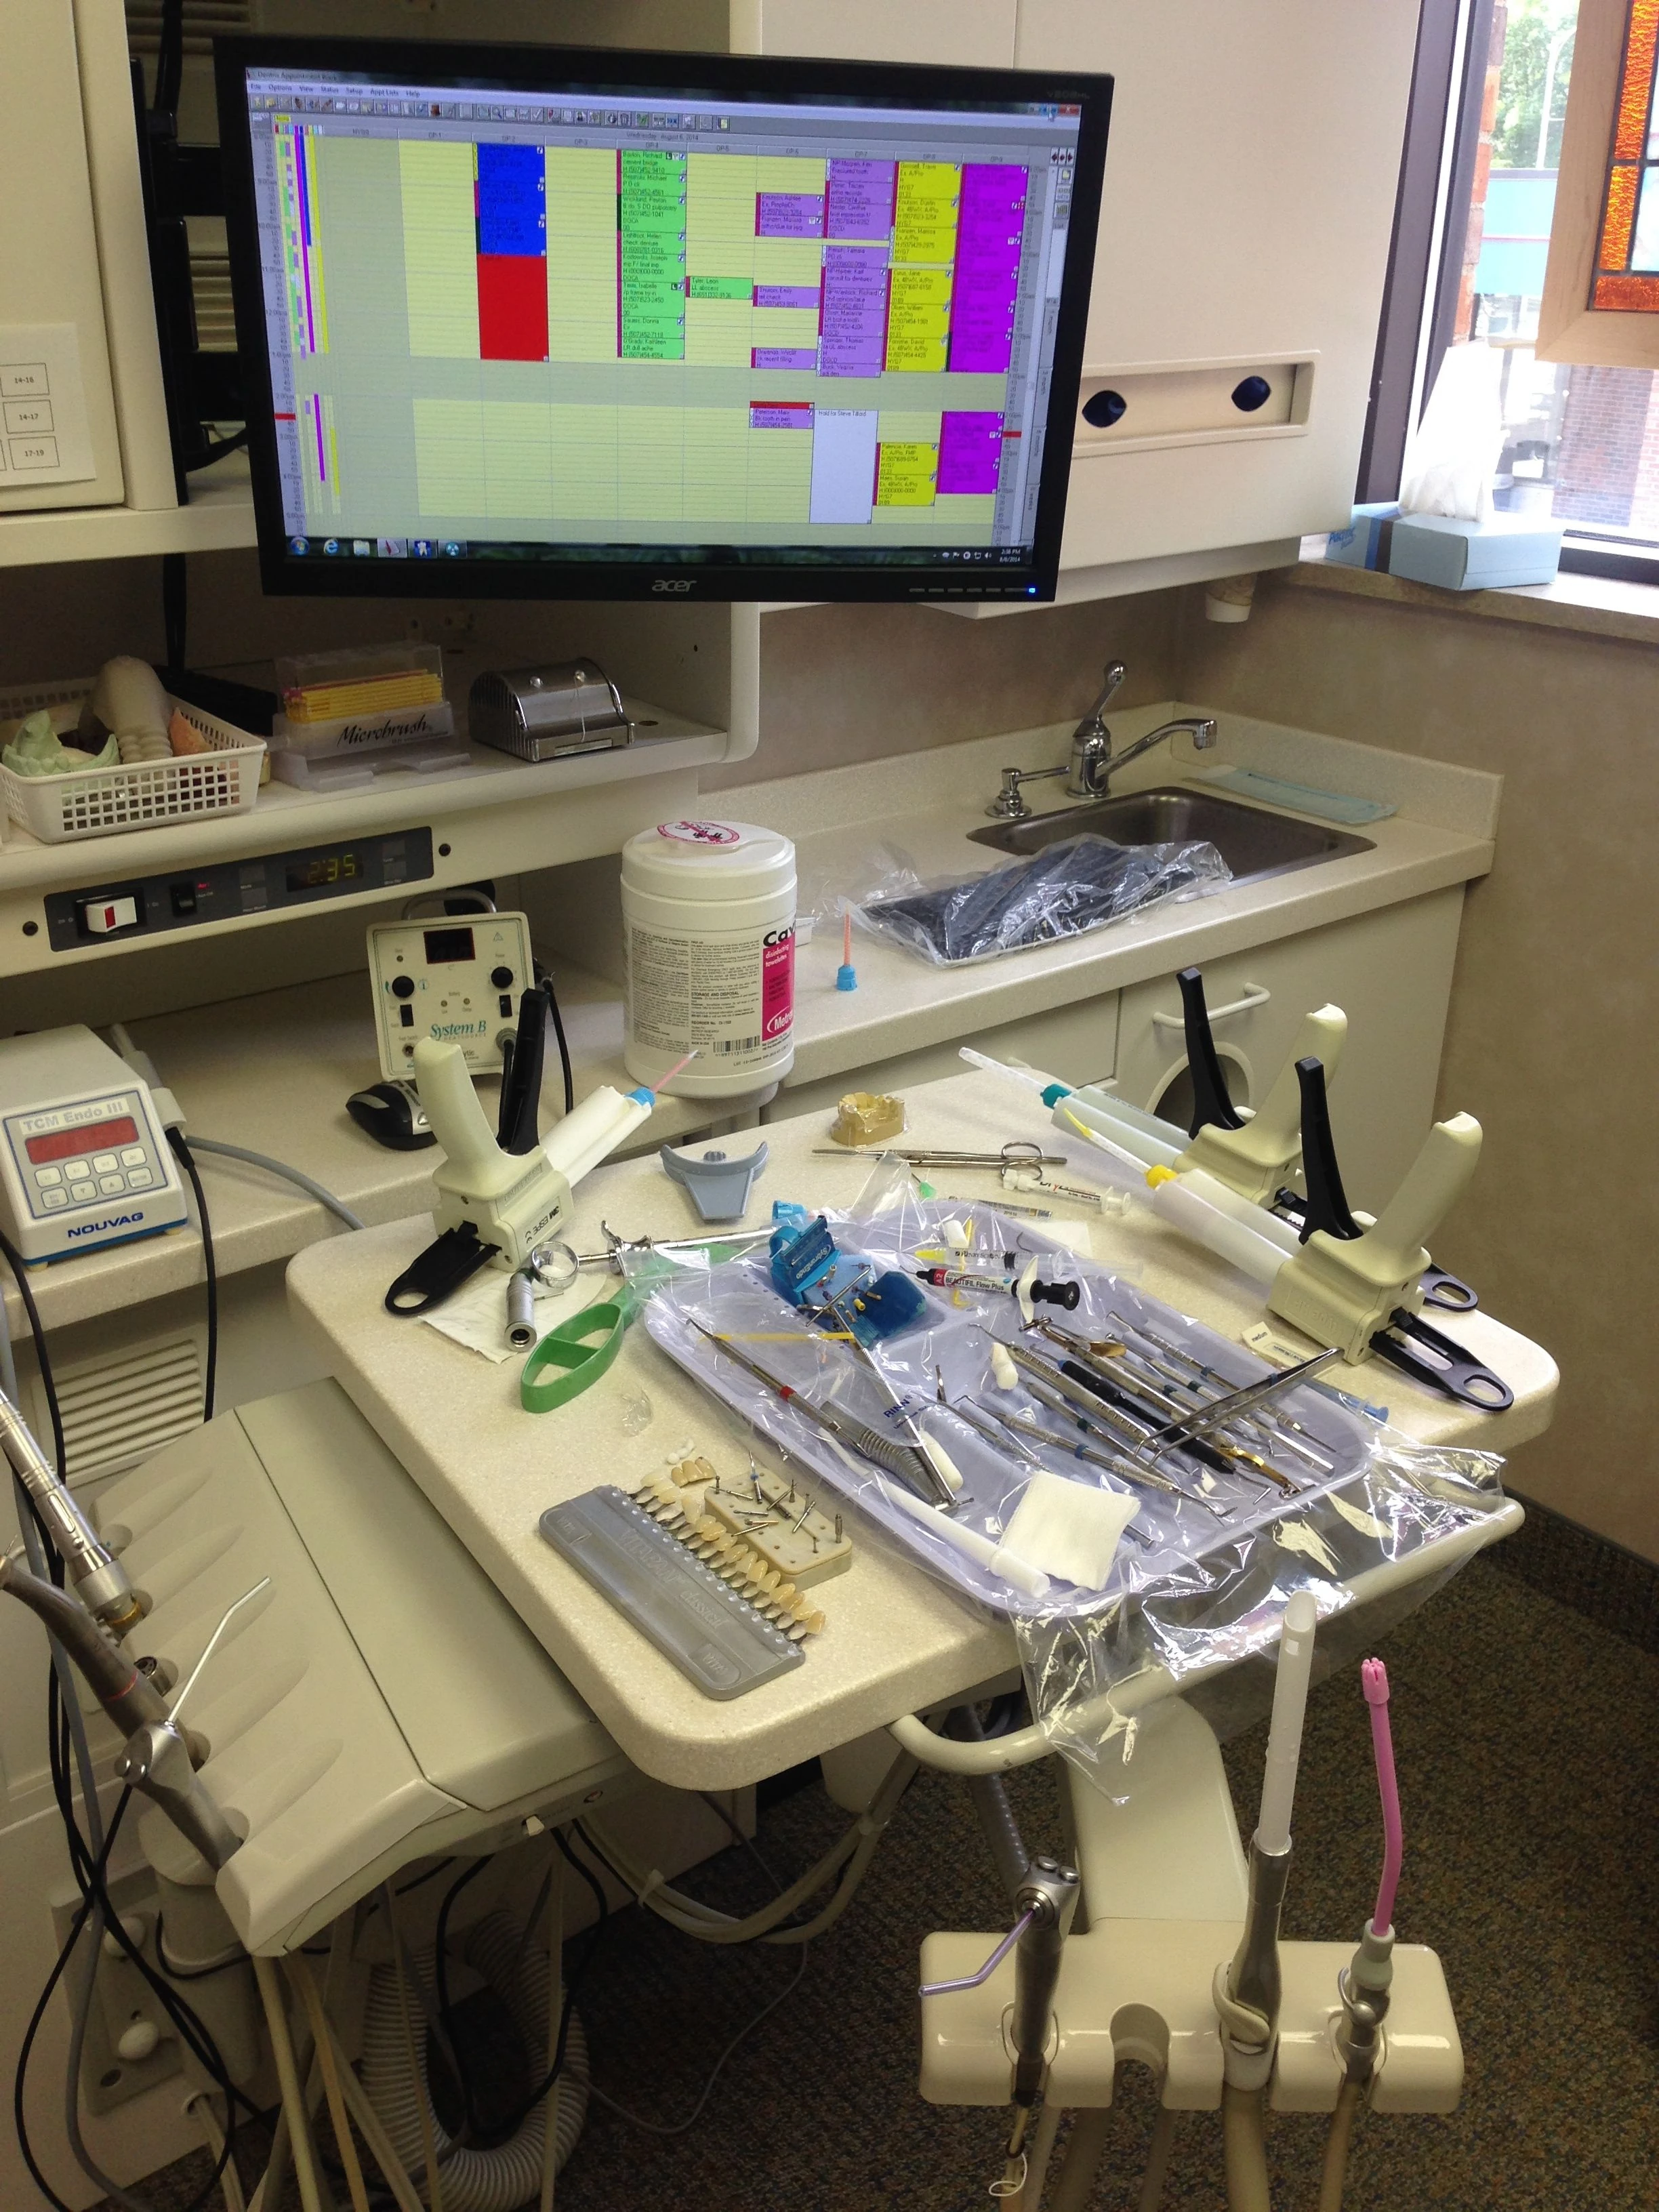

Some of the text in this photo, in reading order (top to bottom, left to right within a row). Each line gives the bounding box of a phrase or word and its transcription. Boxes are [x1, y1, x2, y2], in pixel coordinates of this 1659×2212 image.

[268, 84, 292, 92] Options
[14, 375, 34, 384] 14-16
[19, 413, 39, 421] 14-17
[24, 449, 44, 457] 17-19
[652, 579, 697, 592] acer
[337, 713, 428, 747] Microbrush
[308, 854, 356, 884] 2:35
[765, 943, 790, 960] disinfecting
[765, 954, 787, 968] towelettes
[430, 1019, 487, 1041] System B
[23, 1115, 59, 1133] TCM
[64, 1106, 102, 1124] Endo
[68, 1212, 144, 1238] NOUVAG
[532, 1206, 560, 1235] 3M ESPE
[935, 1273, 943, 1285] A2
[945, 1276, 1005, 1292] BEAUTIFIL Flow Plus
[1251, 1331, 1268, 1342] medium
